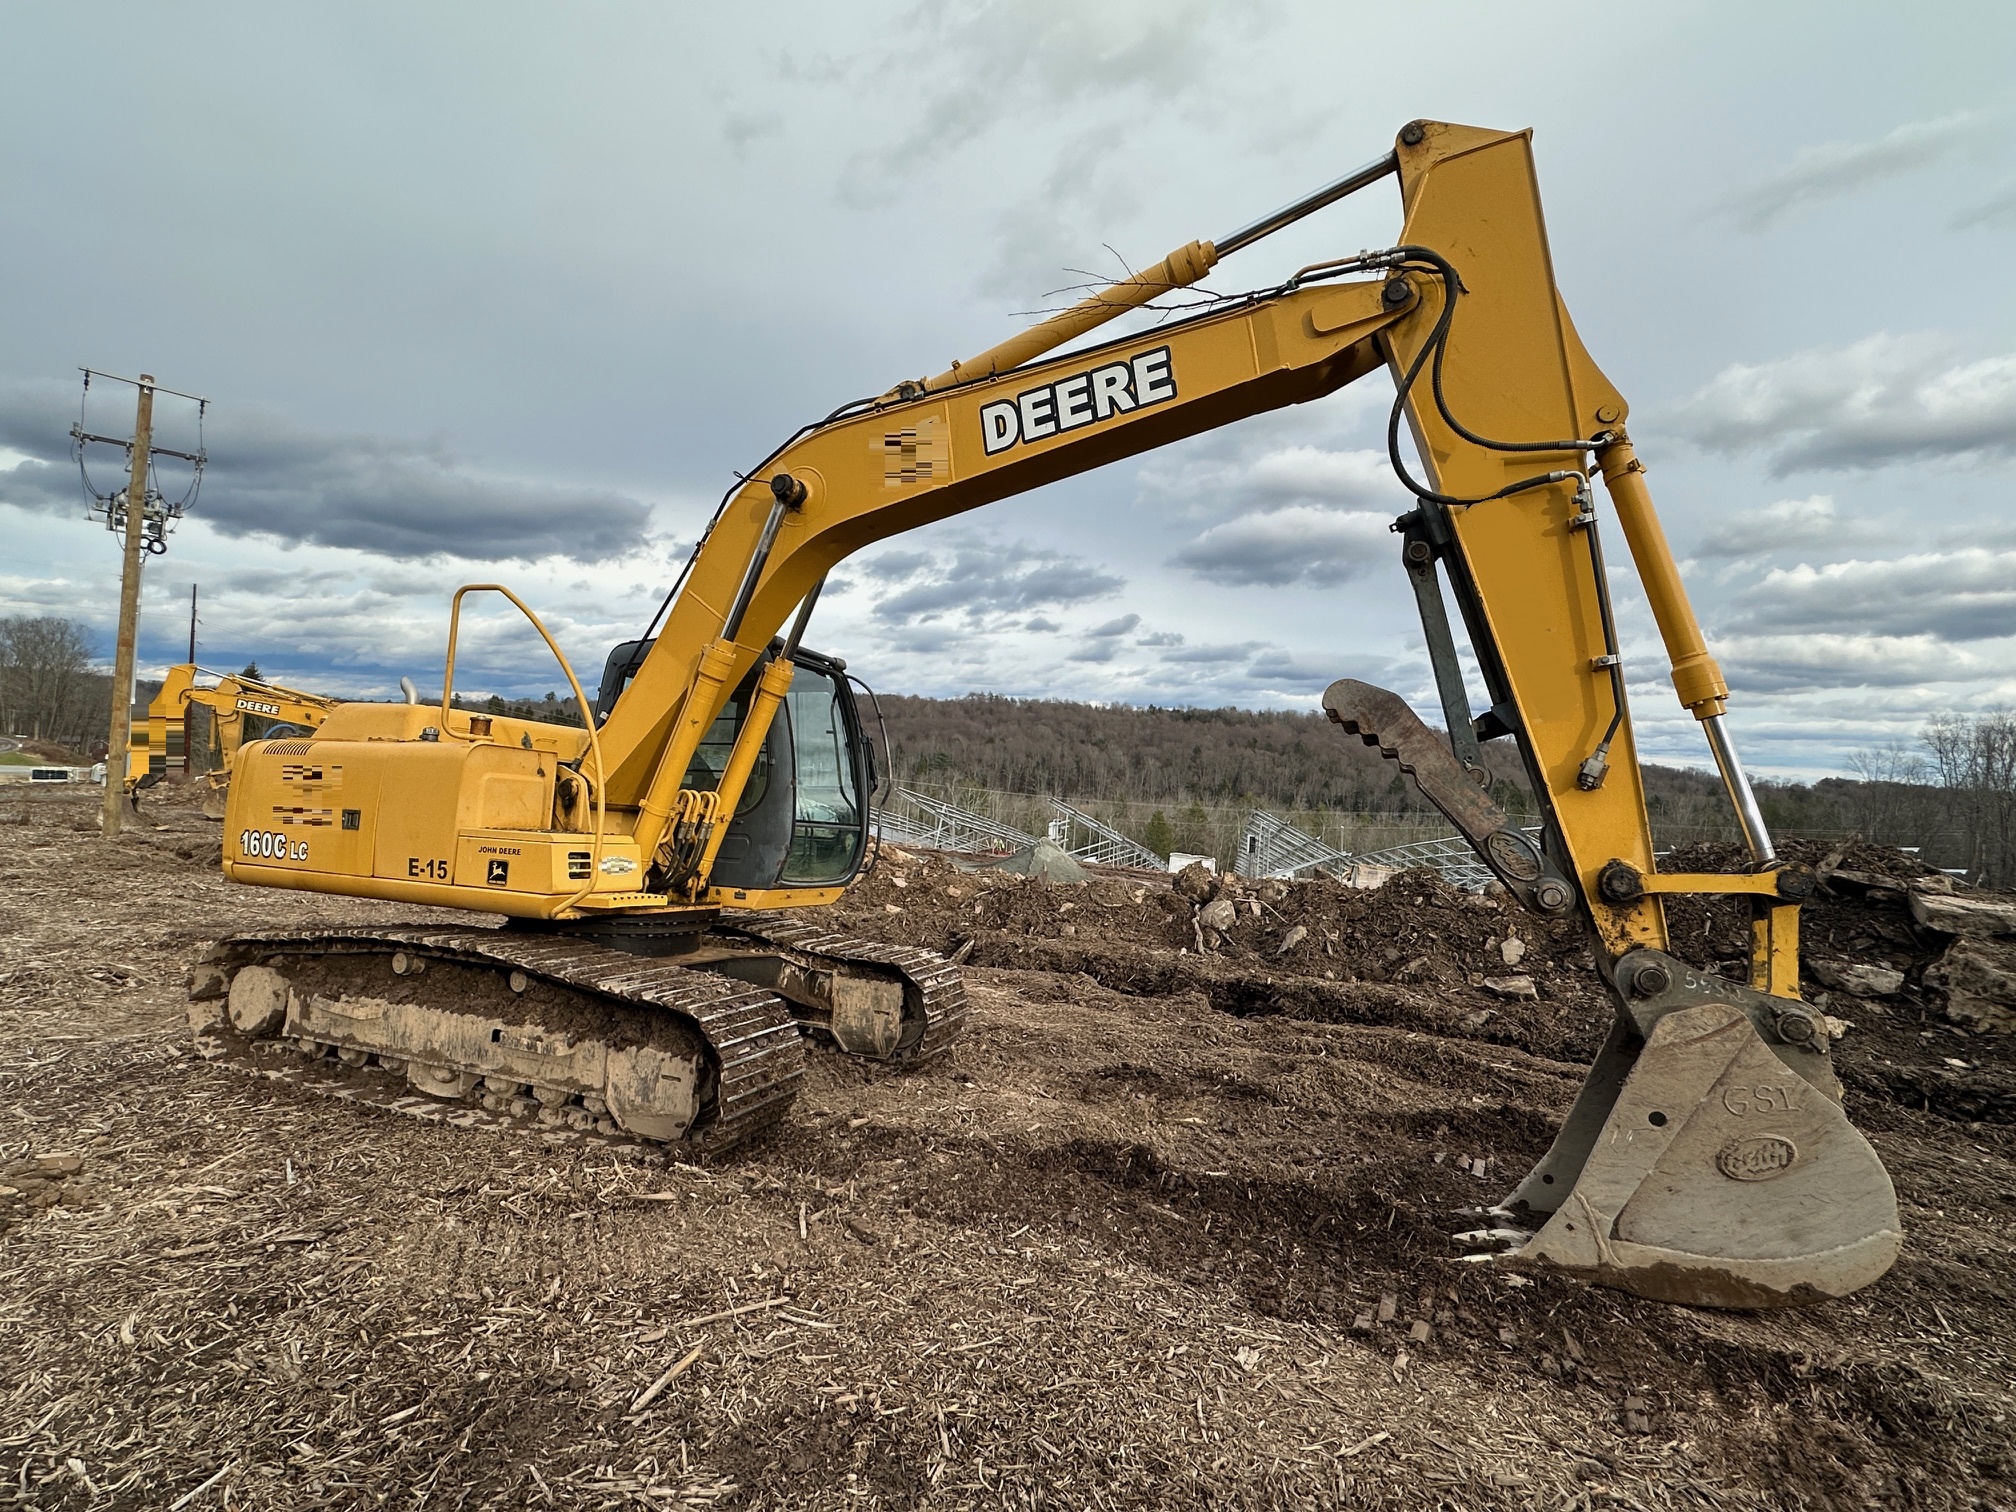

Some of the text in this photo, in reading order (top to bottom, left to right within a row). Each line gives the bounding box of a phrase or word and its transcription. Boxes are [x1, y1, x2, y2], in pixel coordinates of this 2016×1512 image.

[980, 345, 1177, 456] DEERE
[236, 698, 280, 715] DEERE
[240, 829, 308, 861] 160C LC
[478, 846, 521, 856] JOHN DEERE
[408, 857, 448, 880] E-15
